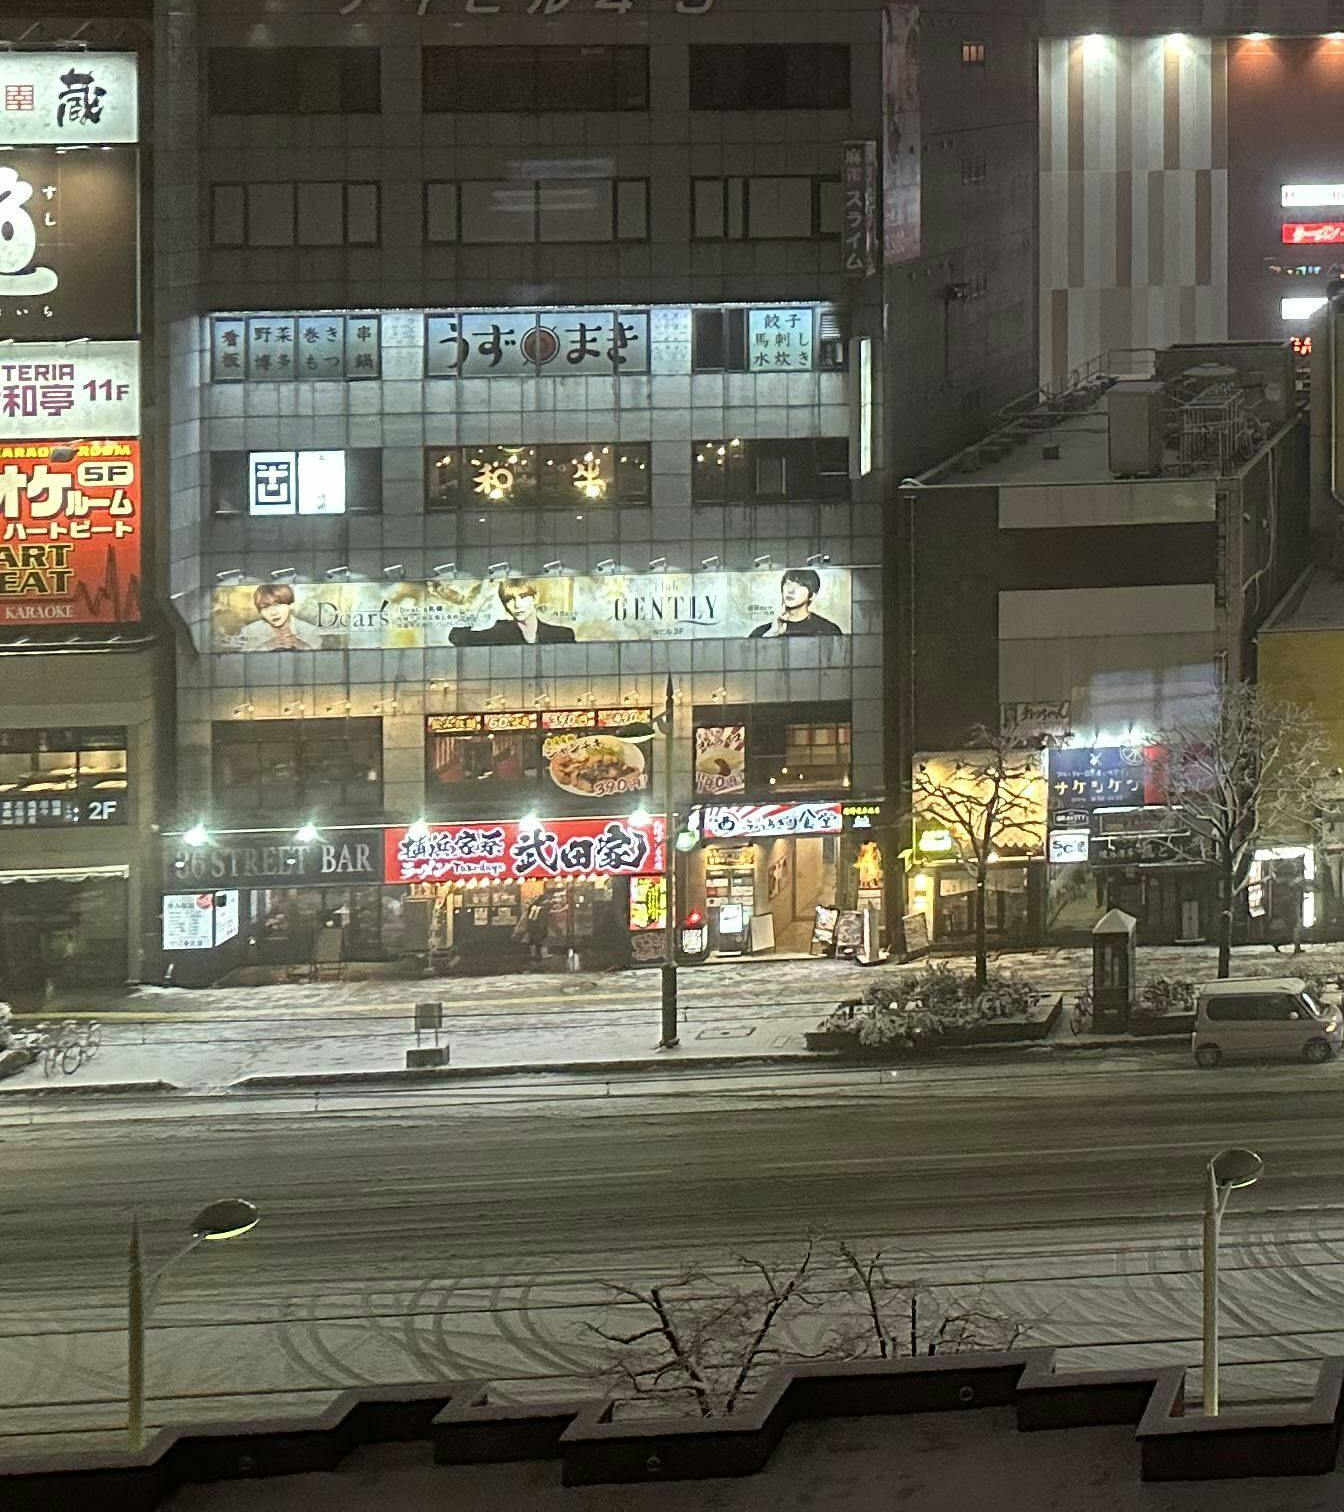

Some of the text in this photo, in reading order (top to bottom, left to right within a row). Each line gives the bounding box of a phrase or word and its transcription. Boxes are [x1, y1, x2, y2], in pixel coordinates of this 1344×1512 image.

[57, 68, 107, 128] 蔵
[42, 185, 57, 226] すし
[0, 305, 54, 318] いち
[764, 313, 802, 330] 餃子
[439, 321, 639, 368] うずまき
[755, 331, 810, 348] 馬刺し
[754, 351, 809, 367] 水炊き
[1, 363, 75, 382] TERIA
[0, 378, 130, 417] 和亭 11F
[84, 467, 129, 482] 5F
[4, 520, 133, 541] ハートビート
[5, 605, 74, 620] KARAOKE
[613, 595, 719, 624] GENTLY
[88, 801, 117, 820] 2F
[512, 824, 649, 874] 武田家
[211, 845, 310, 878] STREET
[320, 843, 374, 873] BAR
